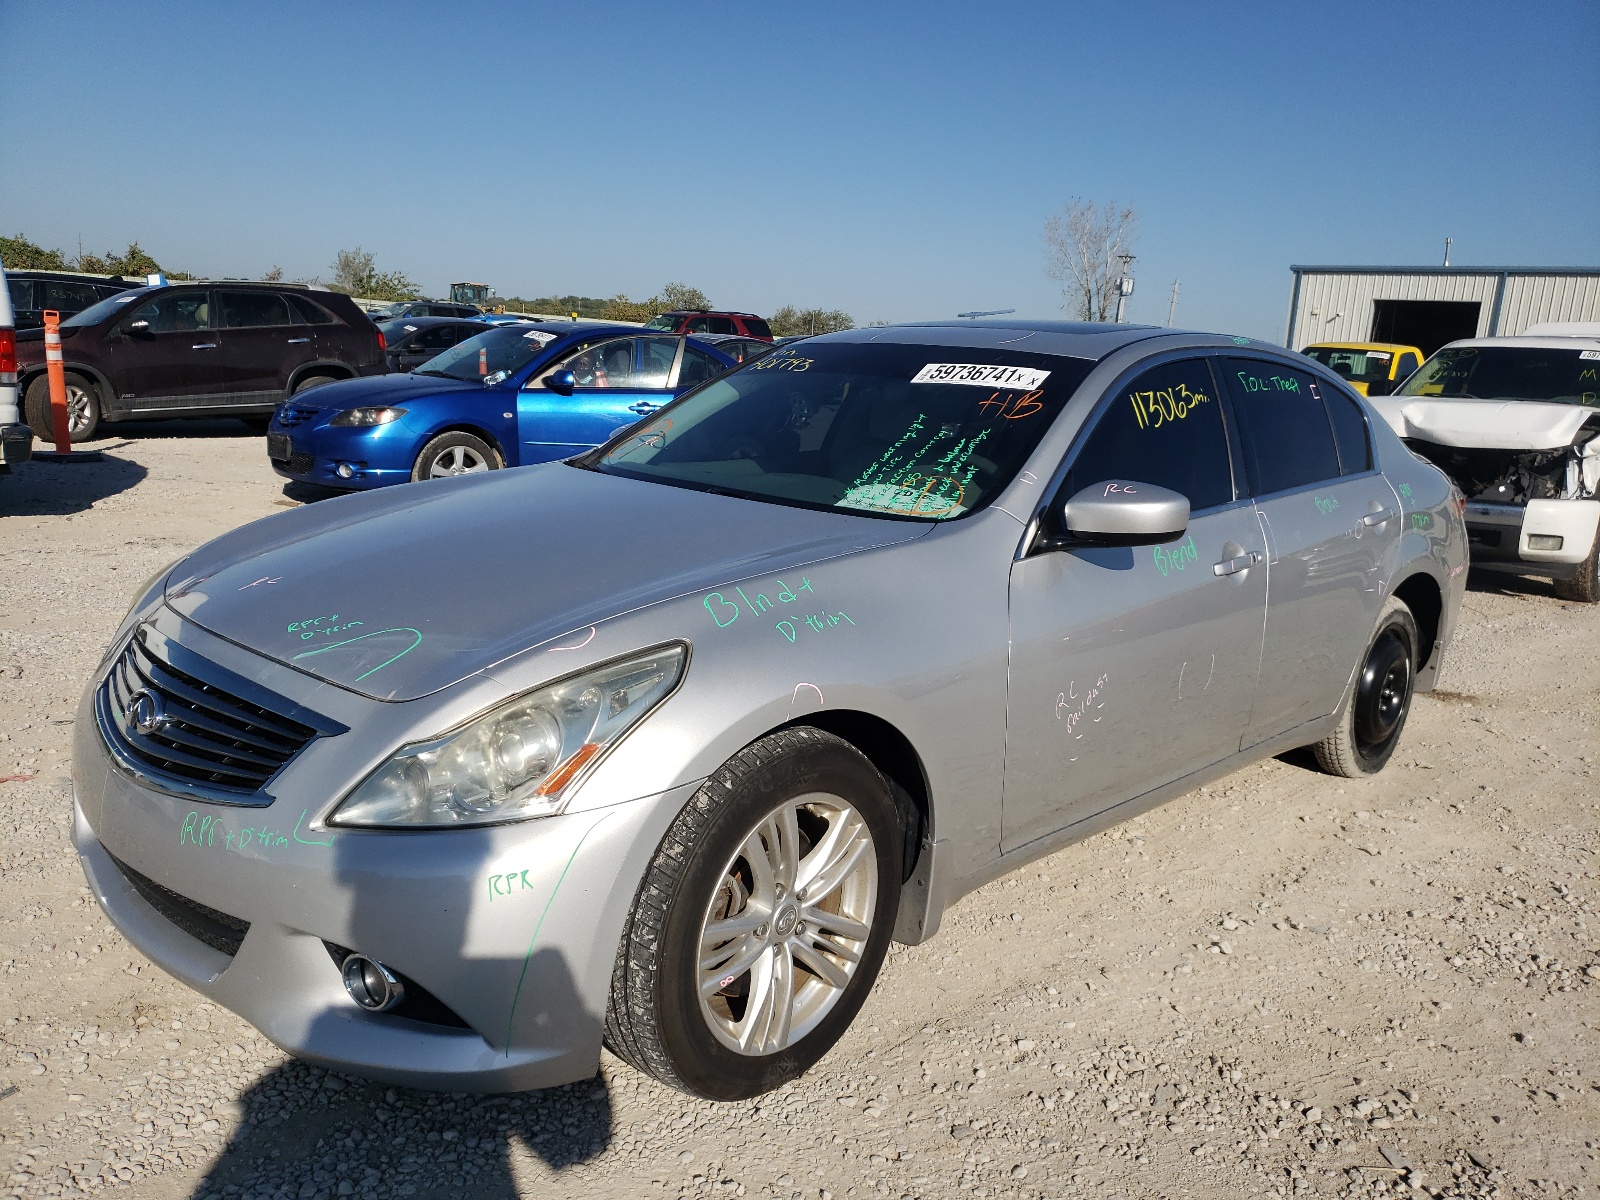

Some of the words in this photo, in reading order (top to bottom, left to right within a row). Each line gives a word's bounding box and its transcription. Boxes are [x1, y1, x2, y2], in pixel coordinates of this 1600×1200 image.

[929, 365, 1018, 384] 59736741
[1270, 375, 1301, 395] Theft
[1153, 535, 1198, 577] Blend
